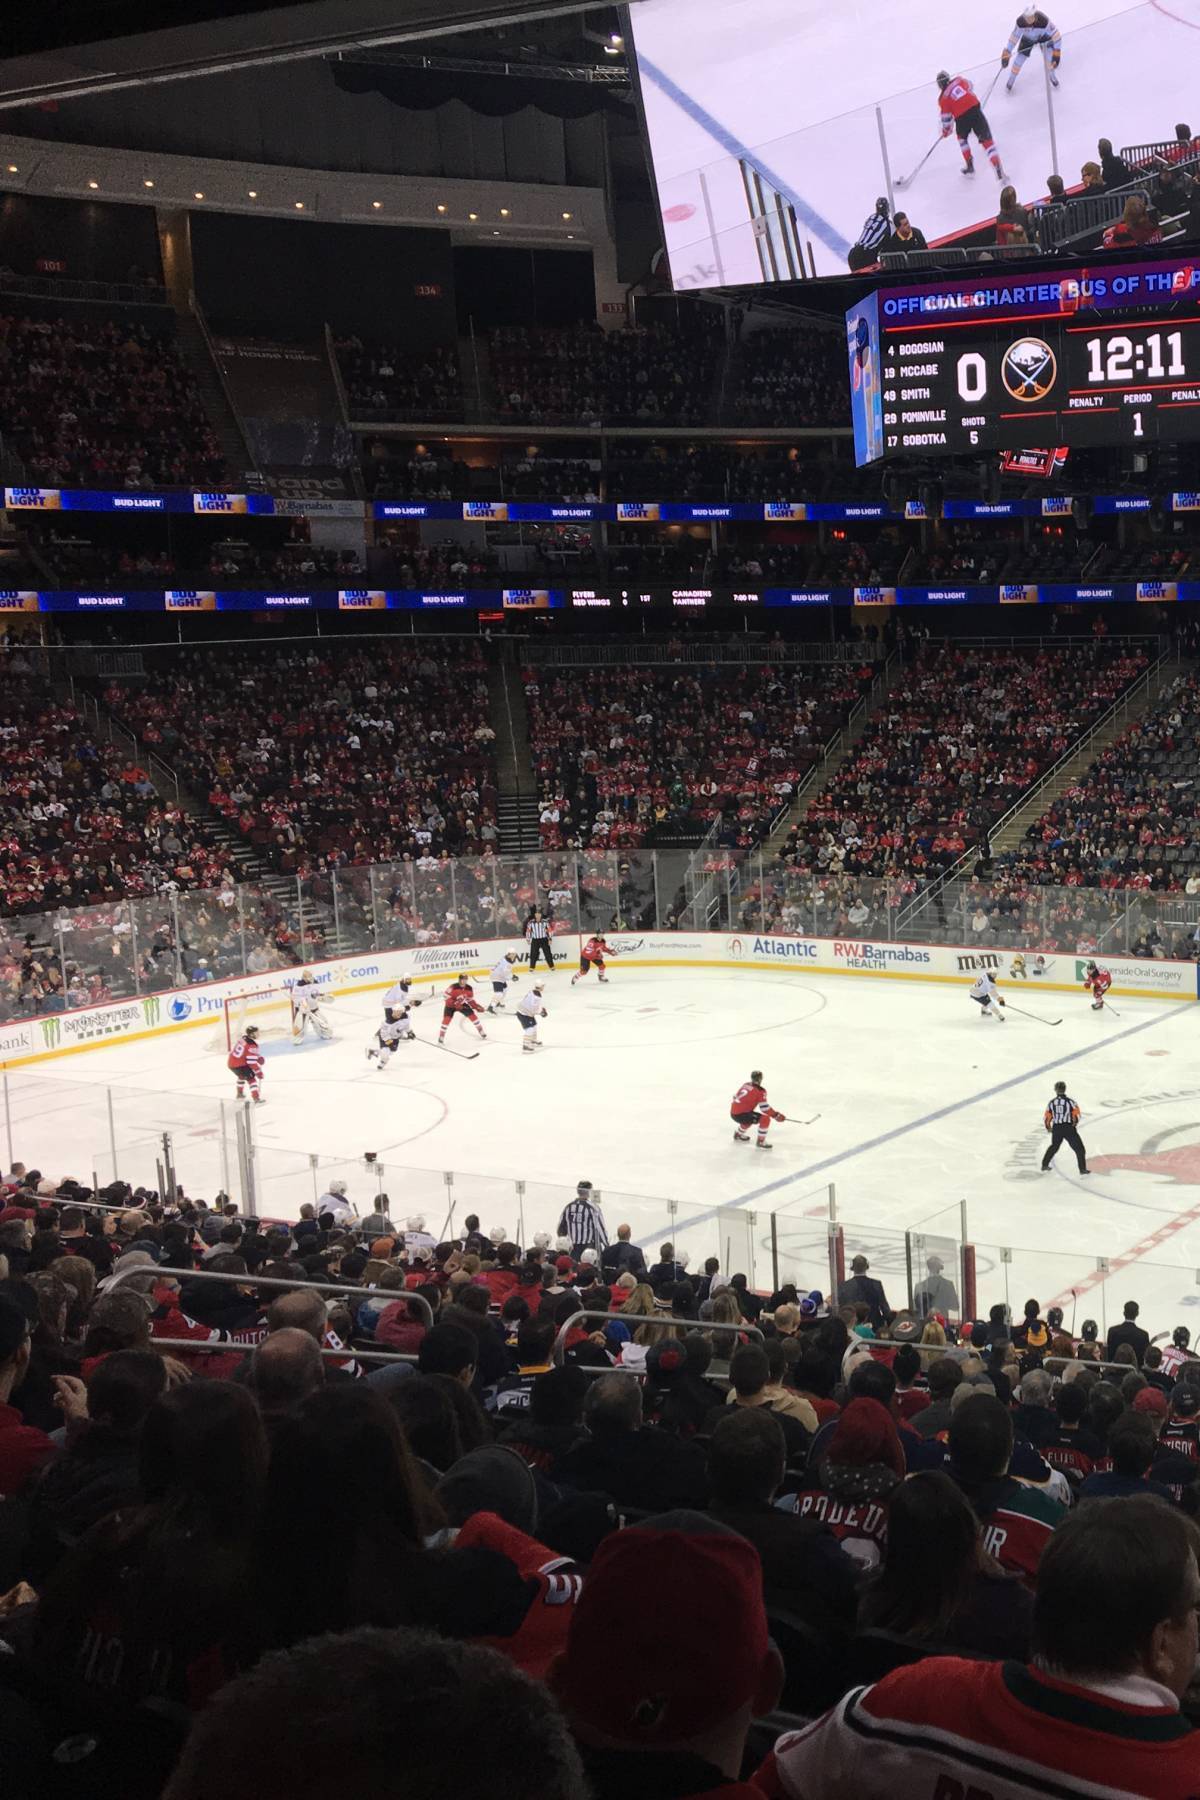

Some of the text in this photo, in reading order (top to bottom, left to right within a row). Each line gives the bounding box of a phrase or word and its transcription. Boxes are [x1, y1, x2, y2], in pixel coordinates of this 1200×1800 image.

[44, 262, 61, 271] 101
[974, 283, 1061, 307] CHARTER
[1069, 278, 1106, 298] BUS
[1112, 275, 1139, 295] OF
[1146, 271, 1185, 291] THE
[888, 341, 944, 356] 4 BOGOSIAN
[1086, 331, 1186, 382] 12:11
[884, 364, 939, 379] 19 MCCABE
[957, 352, 987, 402] 0
[901, 388, 930, 400] SMITH
[1123, 393, 1153, 404] PERIOD
[1069, 397, 1104, 408] PENALTY
[901, 410, 946, 424] POMINVILLE
[961, 416, 986, 426] SHOTS
[1133, 412, 1144, 436] 1
[887, 433, 946, 447] 17 SOBOTKA
[970, 431, 979, 444] 5
[8, 494, 46, 507] LIGHT
[114, 499, 161, 507] BUD LIGHT
[197, 500, 233, 511] LIGHT
[753, 937, 817, 957] Atlantic
[834, 943, 930, 962] RWJBarnabas
[411, 949, 479, 964] William HILL
[847, 958, 887, 969] HEALTH
[421, 960, 470, 971] SPORTS BOOK
[1134, 966, 1182, 980] Oral Surgery
[77, 1022, 130, 1041] ENERGY
